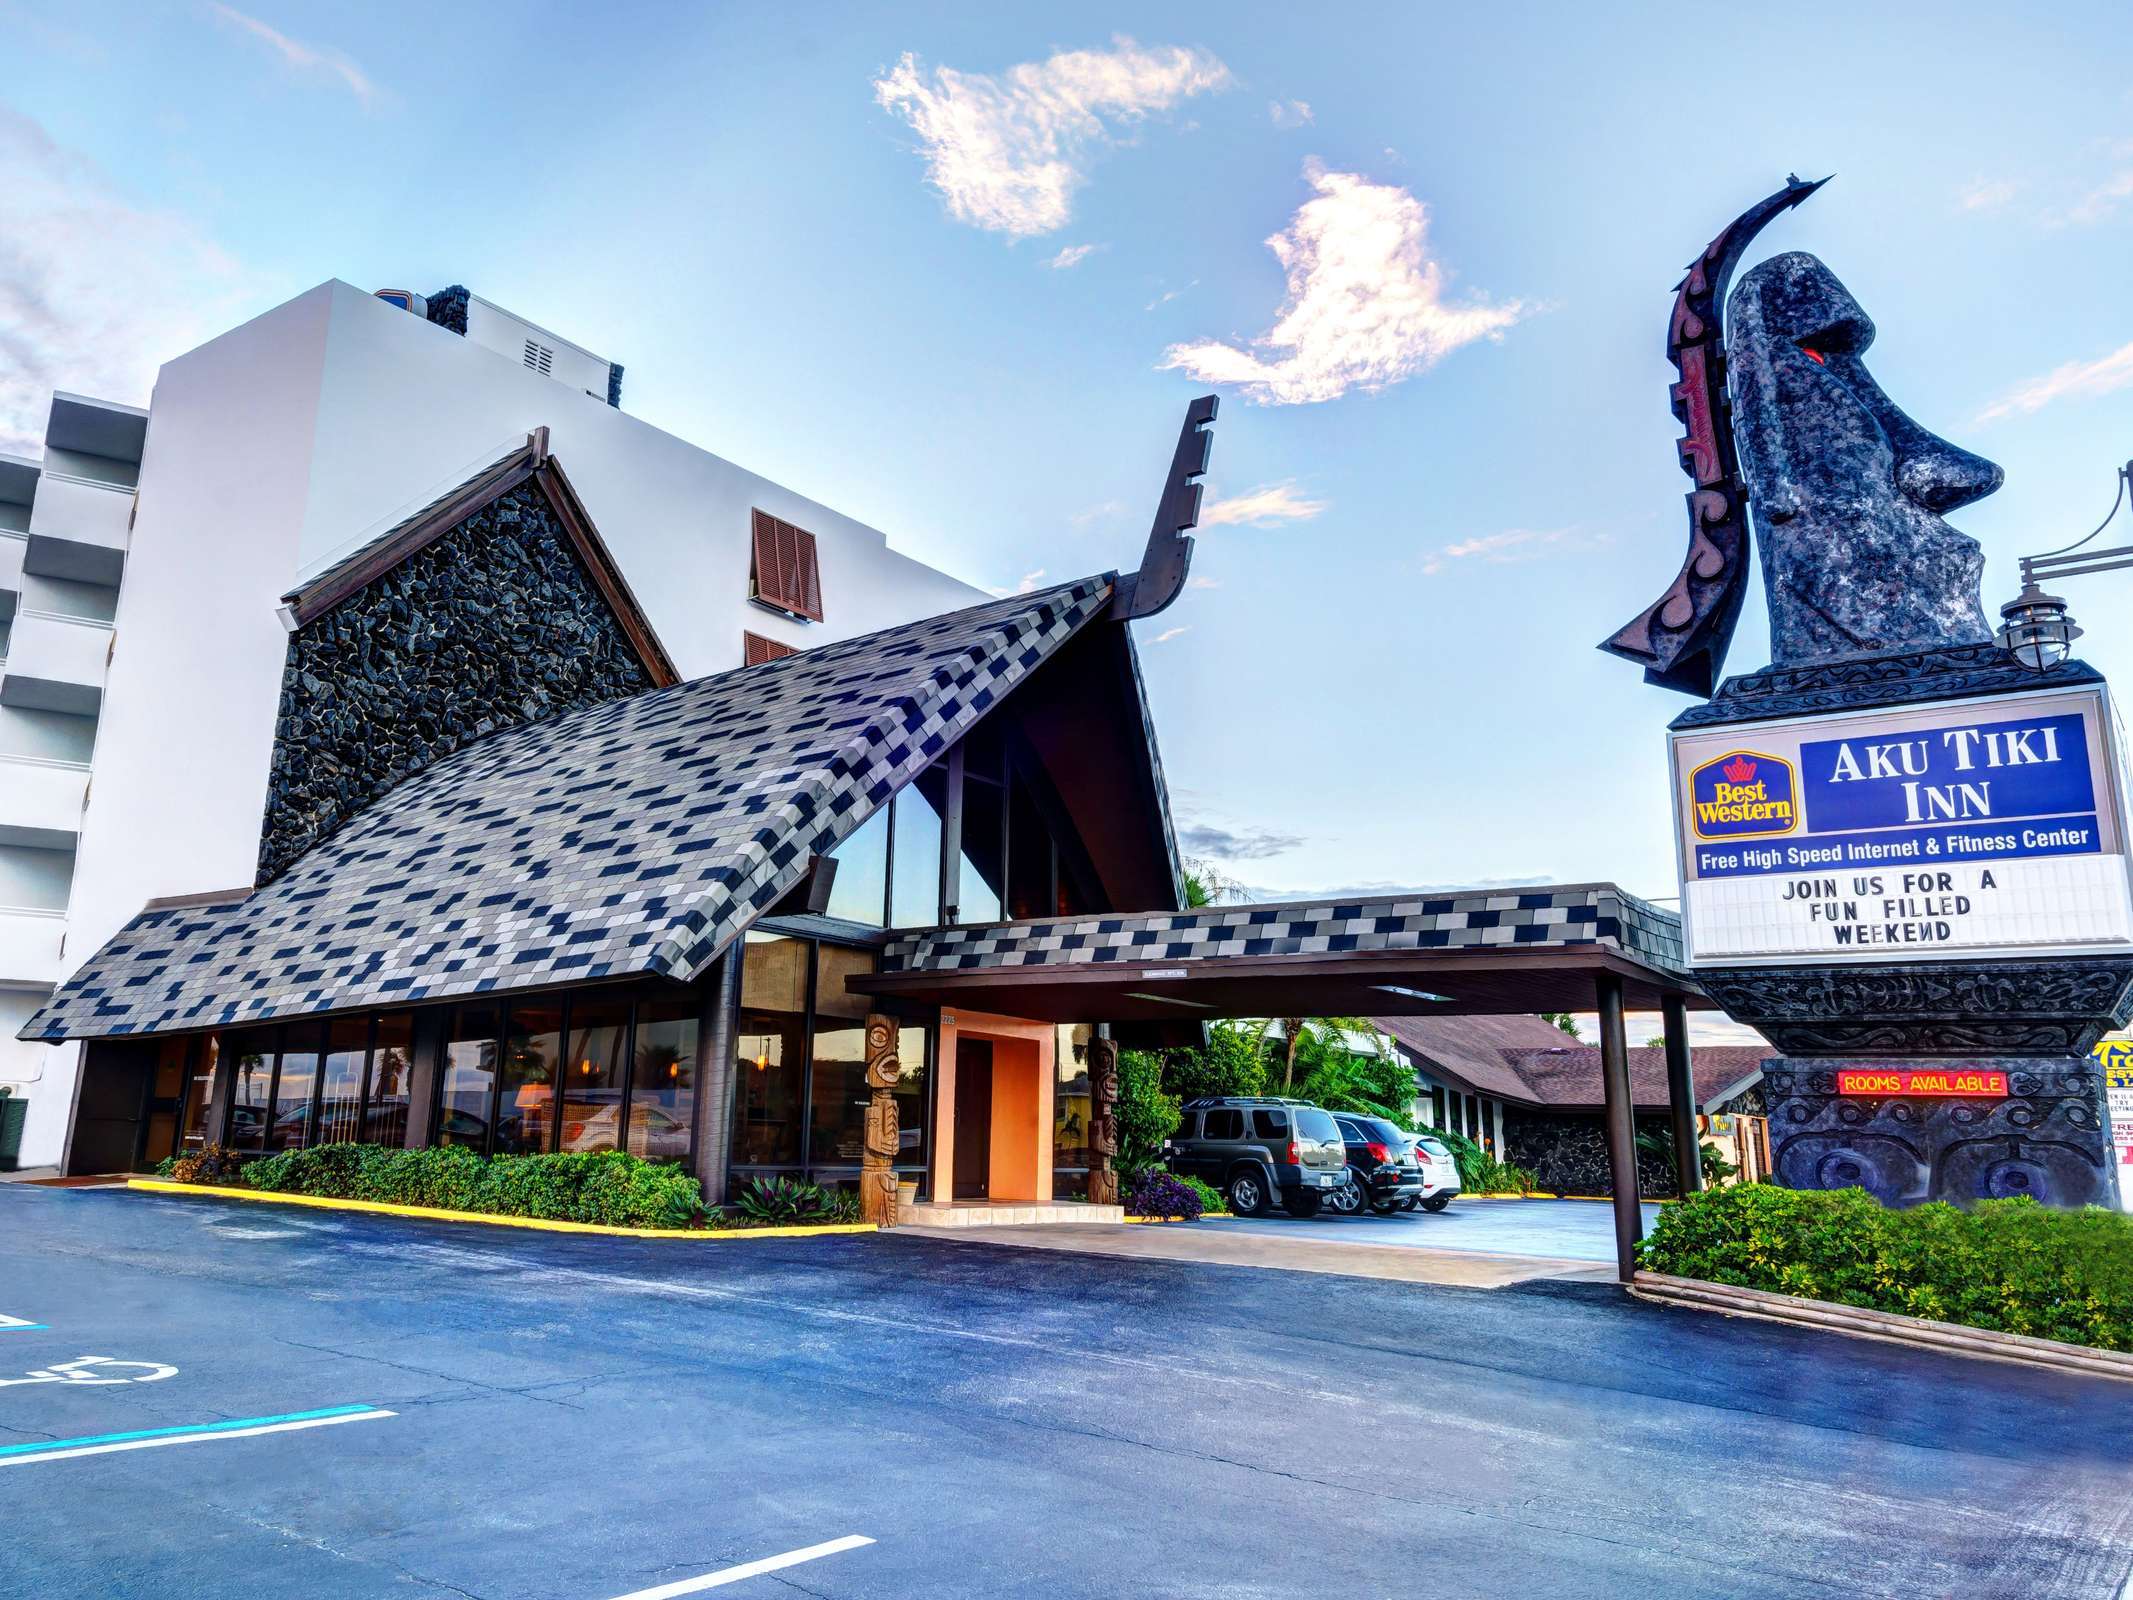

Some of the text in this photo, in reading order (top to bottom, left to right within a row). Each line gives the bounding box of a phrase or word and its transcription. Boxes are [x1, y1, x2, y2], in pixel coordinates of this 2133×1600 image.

[1828, 727, 2062, 783] AKU TIKI
[1714, 779, 1767, 804] Best
[1901, 781, 1991, 822] INN
[1696, 800, 1792, 824] Western
[1701, 828, 2089, 870] Free High Speed Internet & Fitness Center
[1782, 869, 1998, 900] JOIN US FOR A
[1810, 895, 1971, 922] FUN FILLED
[1833, 921, 1951, 945] WEEKEND
[1844, 1075, 2003, 1092] ROOMS AVAILABLE
